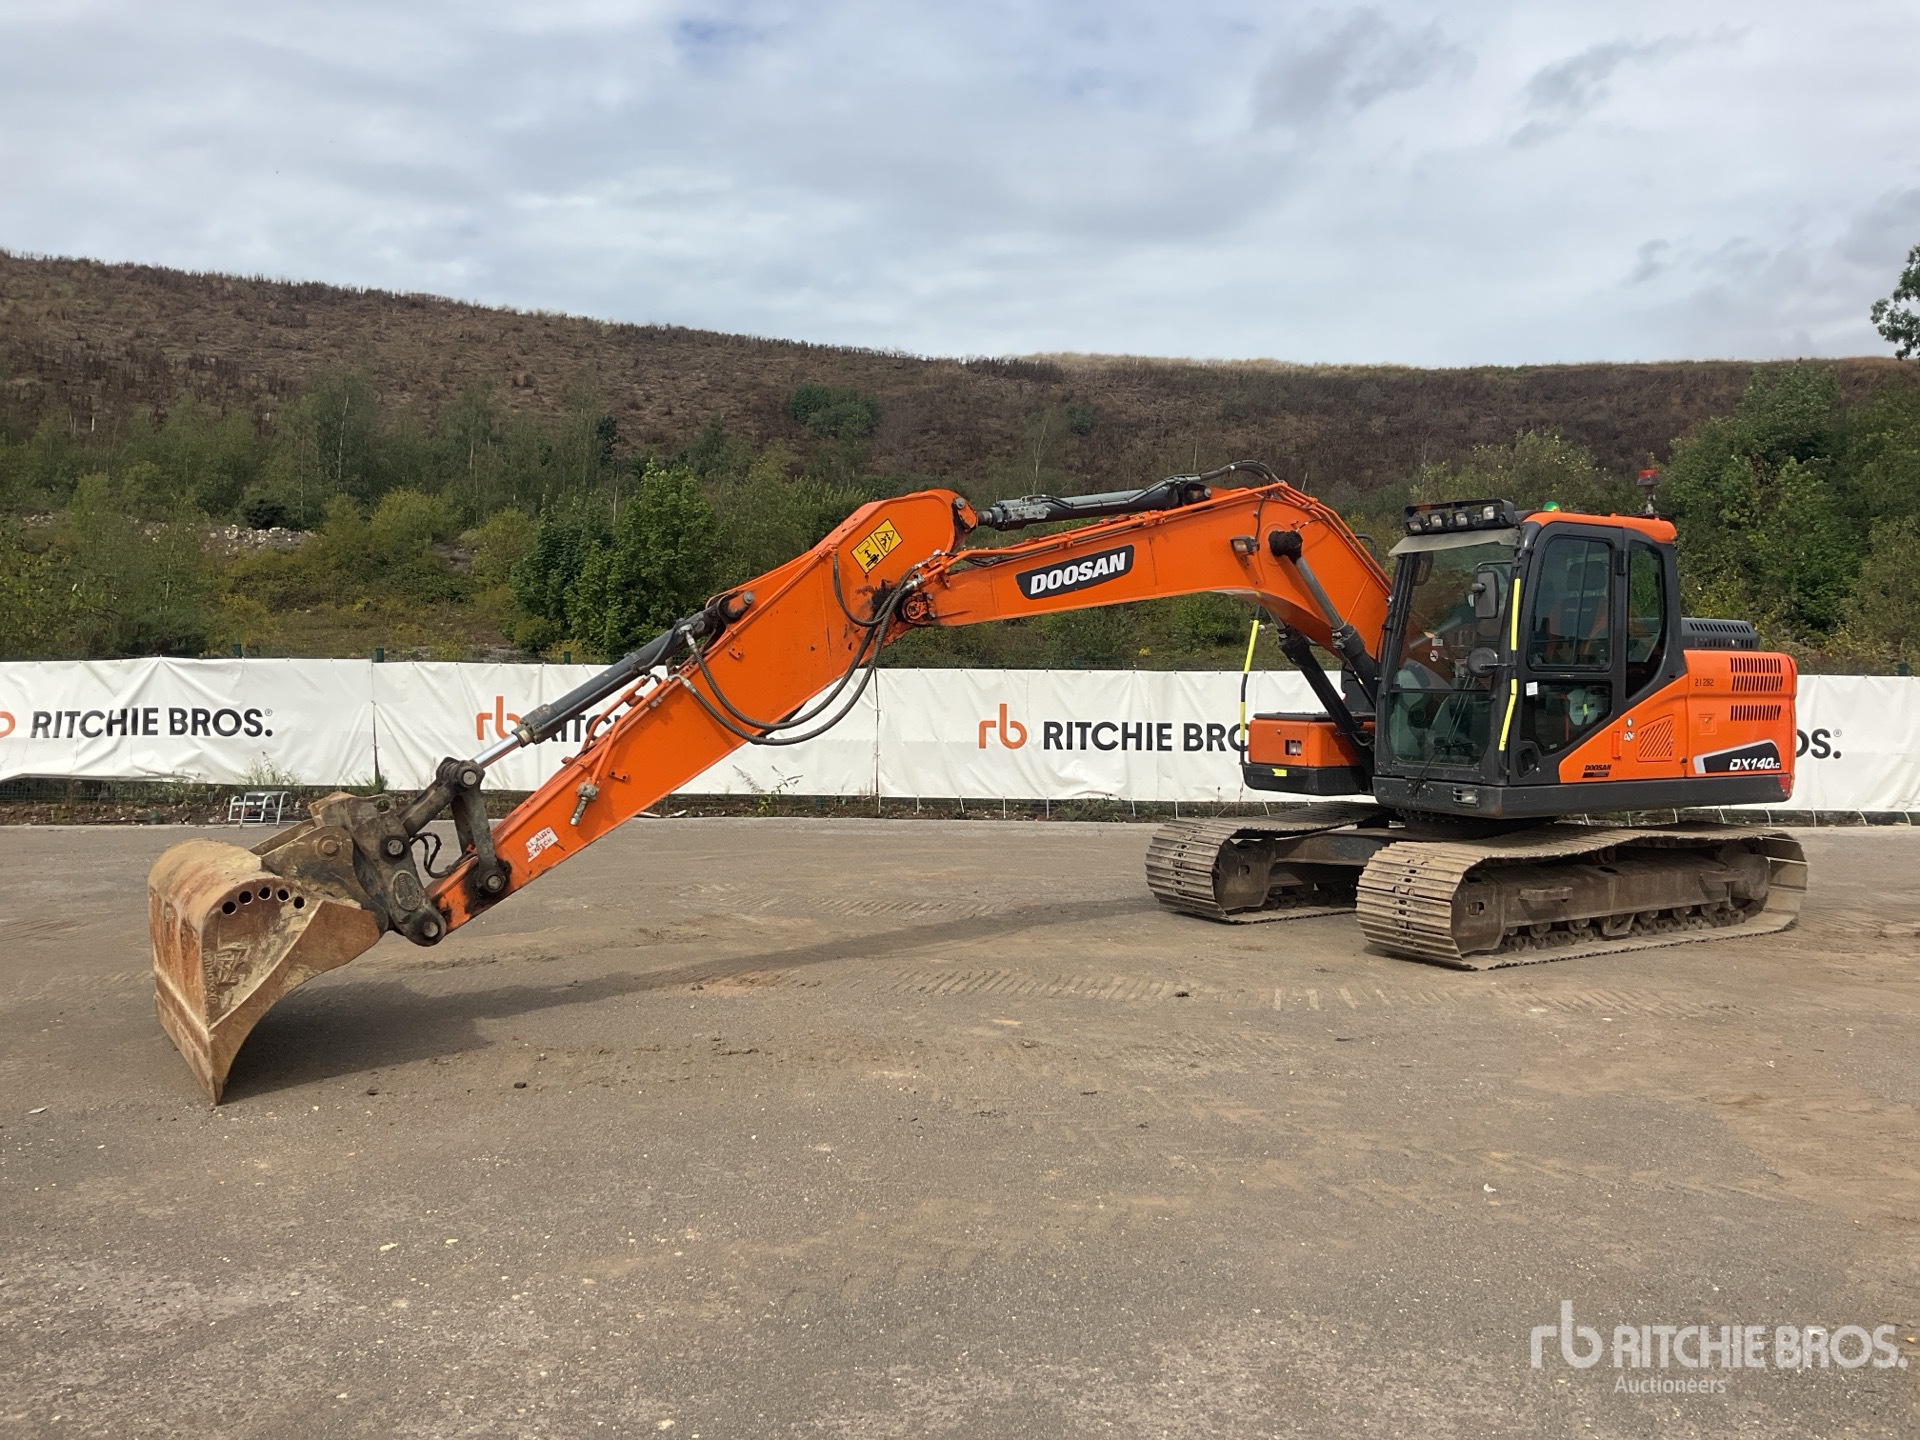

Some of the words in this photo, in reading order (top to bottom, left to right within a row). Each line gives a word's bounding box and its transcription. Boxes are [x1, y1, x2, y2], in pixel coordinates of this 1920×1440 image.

[1030, 552, 1126, 595] DOOSAN
[30, 708, 158, 739] RITCHIE
[979, 703, 1028, 750] rb
[1043, 721, 1173, 752] RITCHIE
[1183, 723, 1250, 752] BRO
